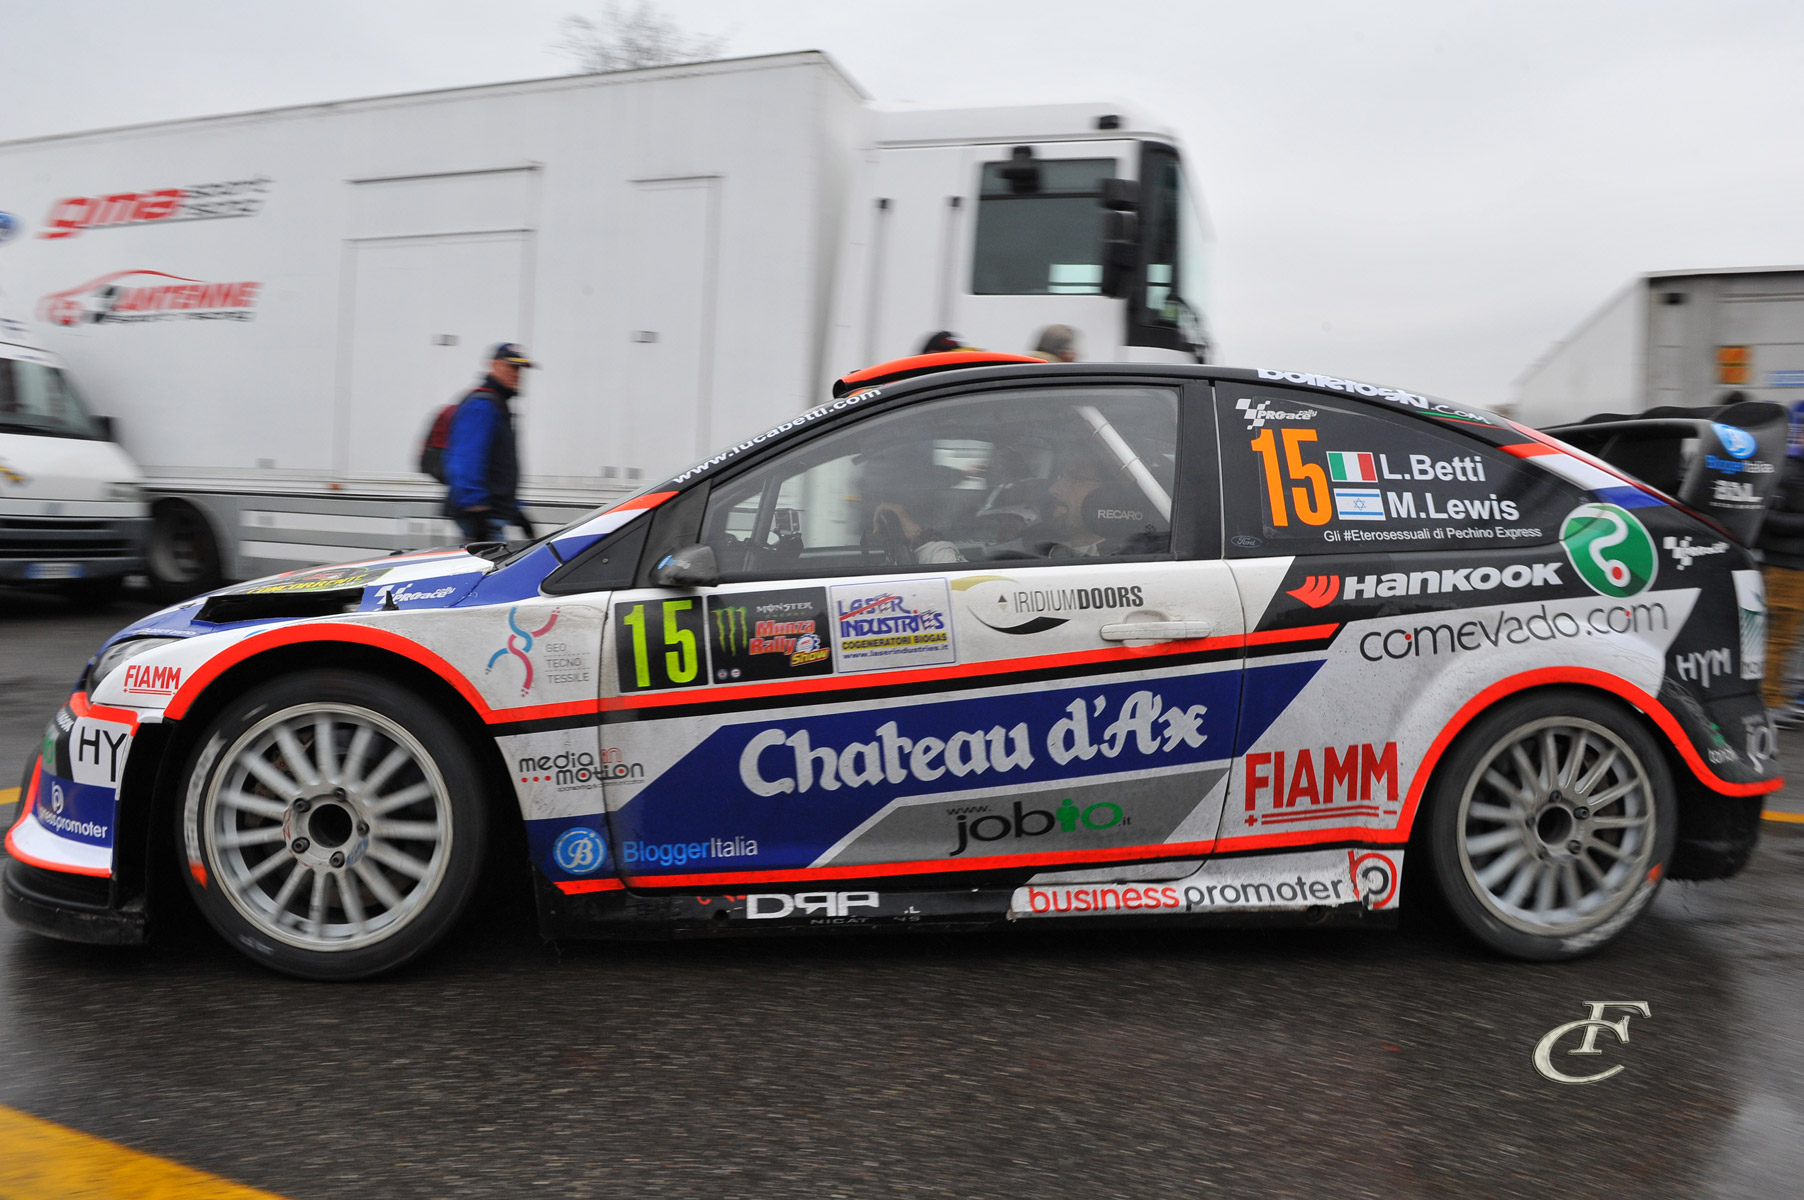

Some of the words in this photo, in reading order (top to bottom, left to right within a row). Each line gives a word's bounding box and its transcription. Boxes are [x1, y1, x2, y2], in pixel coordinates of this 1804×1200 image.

[672, 387, 882, 484] www.lucabetti.com
[1251, 428, 1333, 527] 15
[1379, 453, 1486, 482] L.Betti
[1097, 509, 1143, 520] RECARO
[1386, 491, 1520, 521] M.Lewis
[1323, 530, 1341, 543] Gli
[1343, 526, 1431, 542] #Eterosessuali
[1433, 527, 1444, 540] di
[1446, 526, 1494, 539] Pechino
[1495, 526, 1543, 541] Express
[1013, 585, 1144, 613] IRIDIUMDOORS
[623, 599, 698, 688] 15
[749, 635, 797, 655] Rally
[842, 636, 912, 650] COGENERATORI
[914, 633, 948, 645] BIOGAS
[1359, 603, 1669, 662] comevado.com
[545, 643, 567, 653] GEO
[546, 657, 582, 669] TECNO
[124, 664, 182, 690] FIAMM
[546, 672, 590, 684] TESSILE
[738, 720, 1036, 798] Chateau
[1046, 690, 1208, 767] d'Ax
[519, 751, 594, 772] media
[556, 763, 644, 785] motion
[1245, 742, 1399, 811] FIAMM
[622, 835, 759, 867] BloggerItalia
